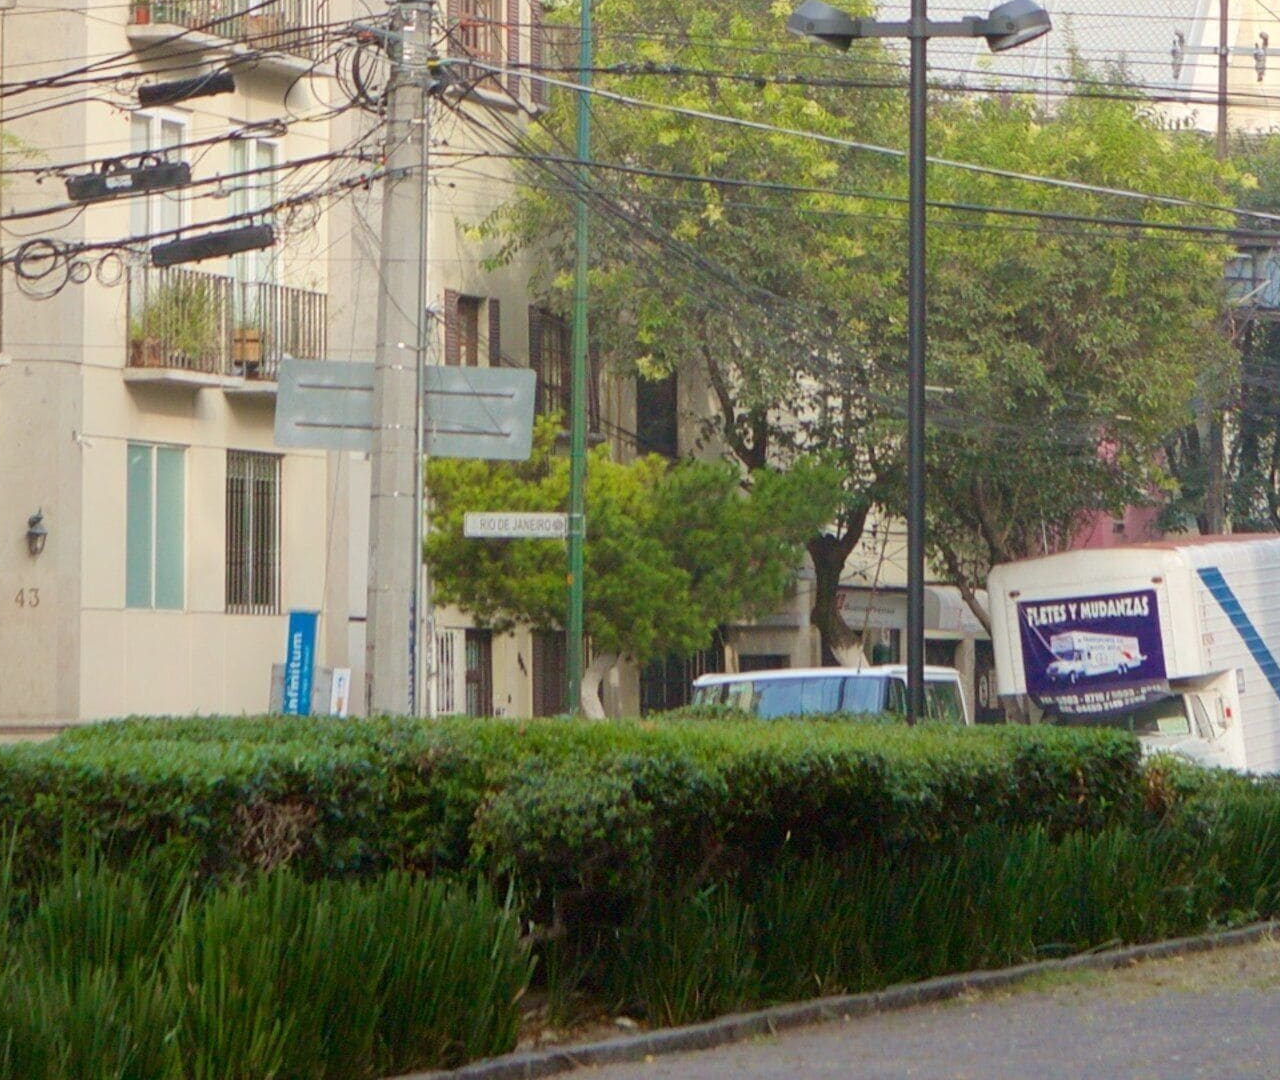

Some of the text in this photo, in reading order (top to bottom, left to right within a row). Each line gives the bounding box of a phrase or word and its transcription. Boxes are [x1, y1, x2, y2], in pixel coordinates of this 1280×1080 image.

[479, 518, 551, 532] RIO DE JANEIRO
[14, 588, 40, 608] 43
[1026, 596, 1149, 627] FLETES Y MUDANZAS
